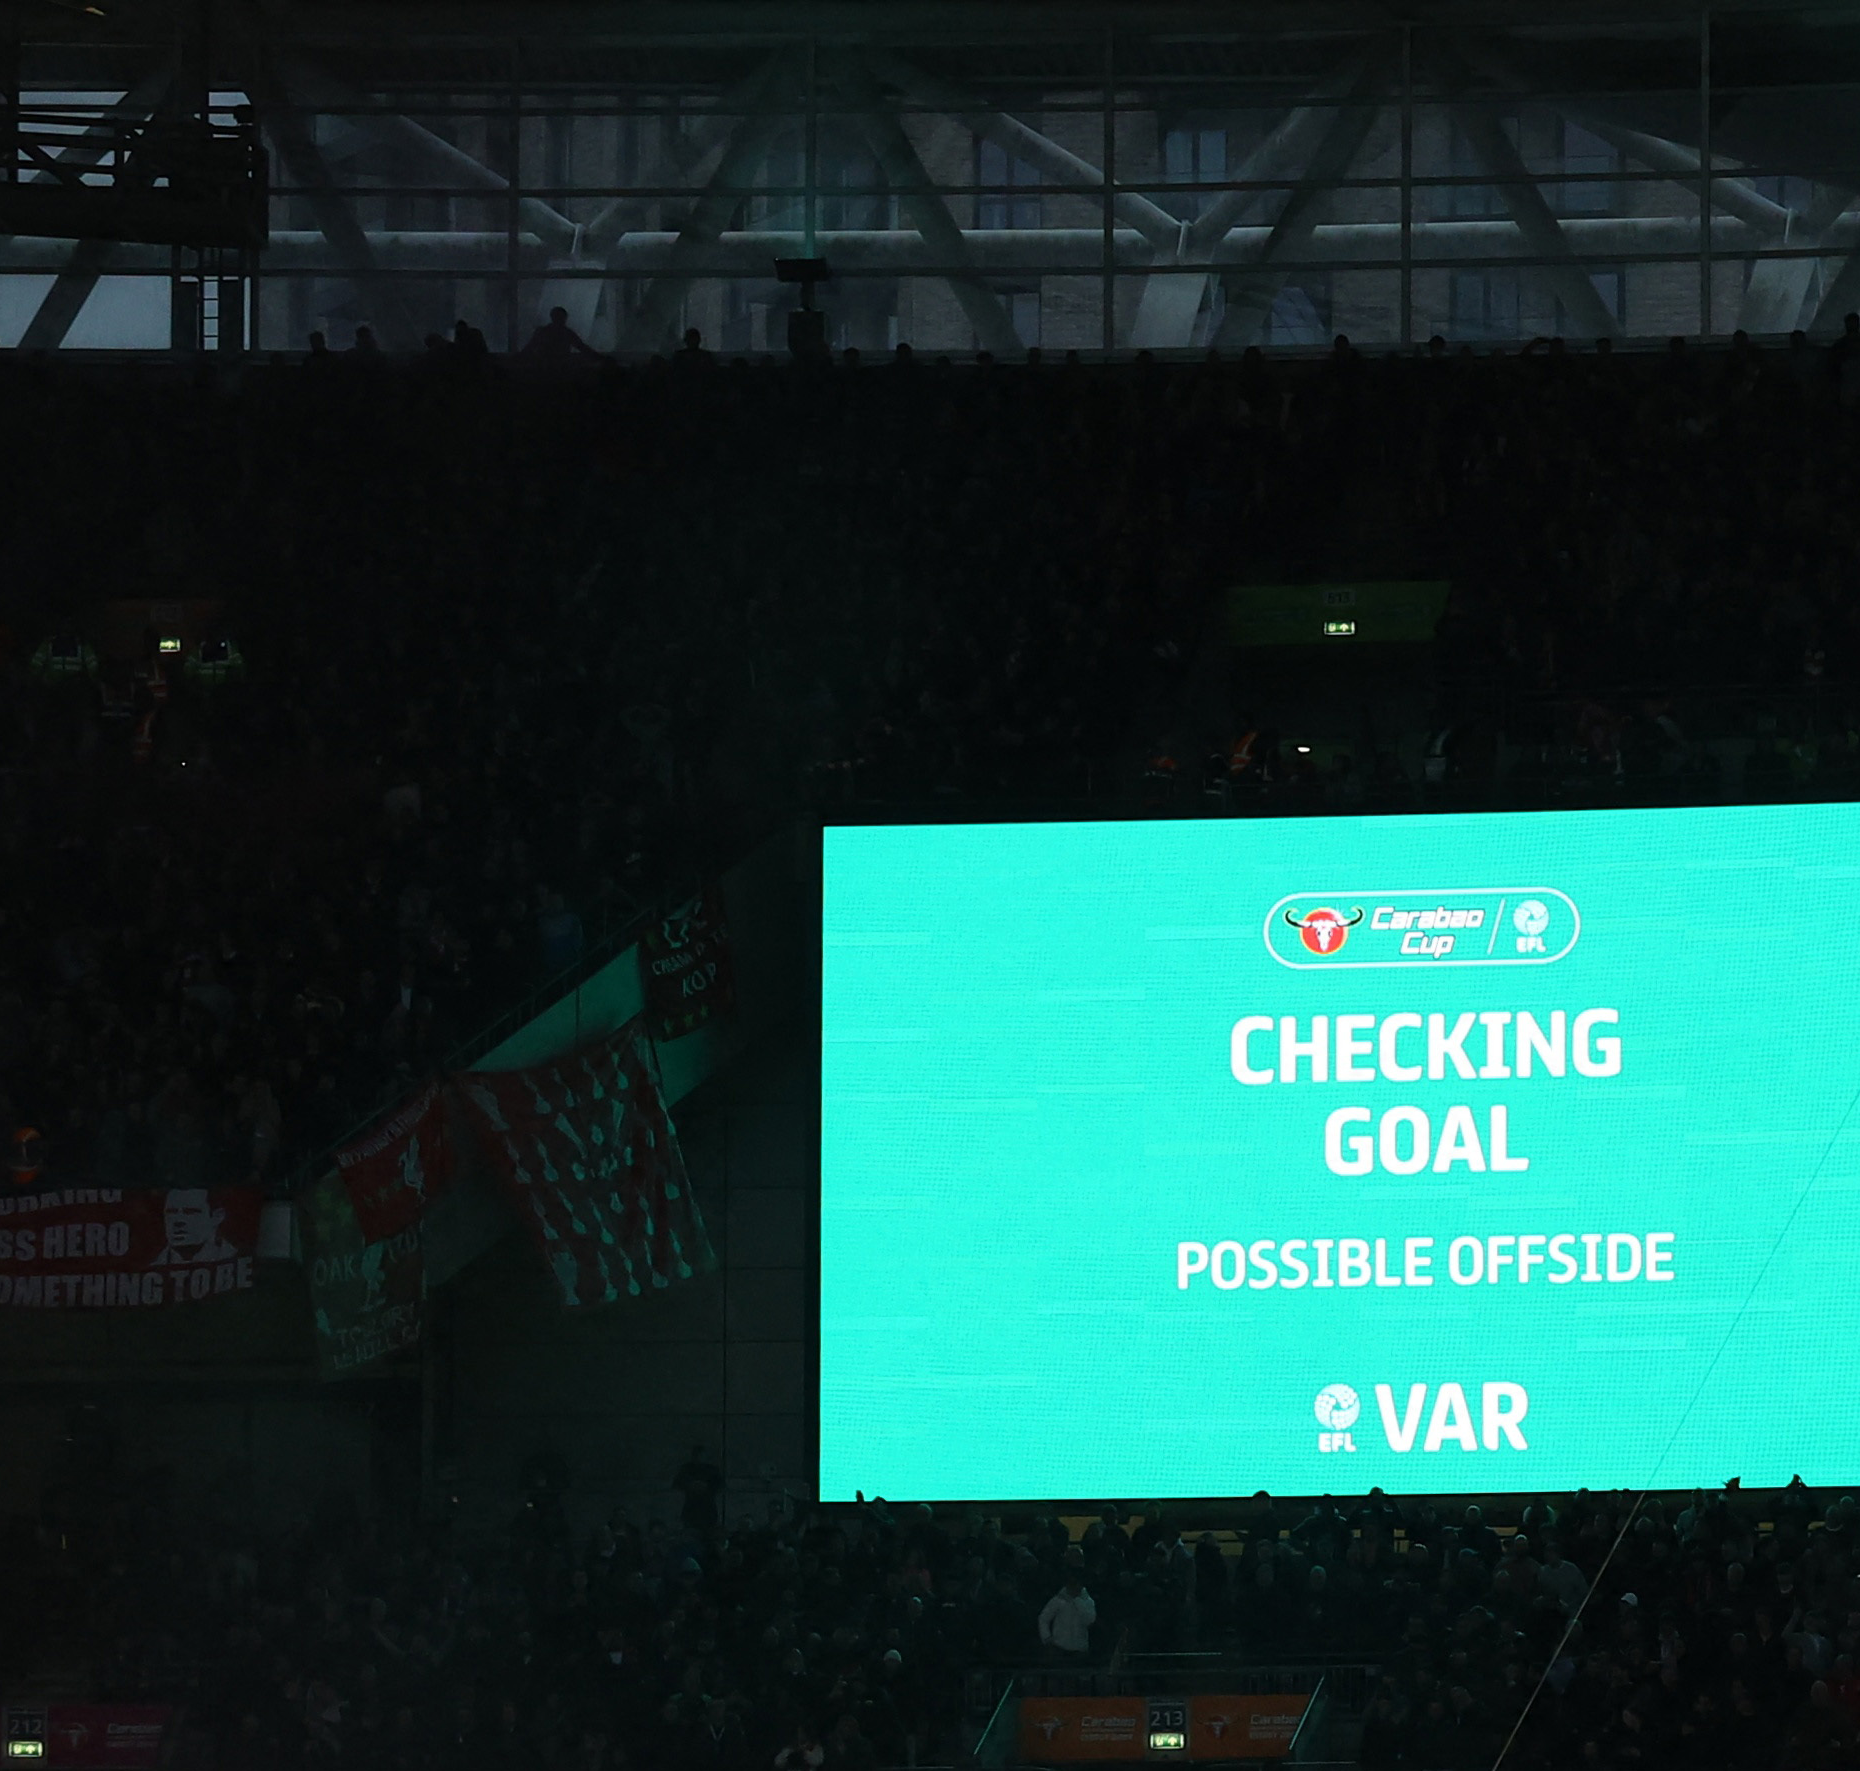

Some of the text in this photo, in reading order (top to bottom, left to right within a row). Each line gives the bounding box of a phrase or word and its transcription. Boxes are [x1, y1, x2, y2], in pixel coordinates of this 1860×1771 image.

[1370, 906, 1485, 931] Carabao
[1400, 931, 1455, 958] Cup
[1516, 937, 1546, 953] EFL
[1230, 1007, 1622, 1086] CHECKING
[1324, 1104, 1530, 1177] GOAL
[42, 1219, 131, 1261] HERO
[170, 1267, 208, 1302] TO
[213, 1255, 255, 1296] BE
[1177, 1232, 1675, 1291] POSSIBLE OFFSIDE
[1374, 1381, 1529, 1453] VAR
[1317, 1432, 1357, 1453] EFL
[8, 1716, 44, 1738] 212
[1150, 1709, 1186, 1728] 213
